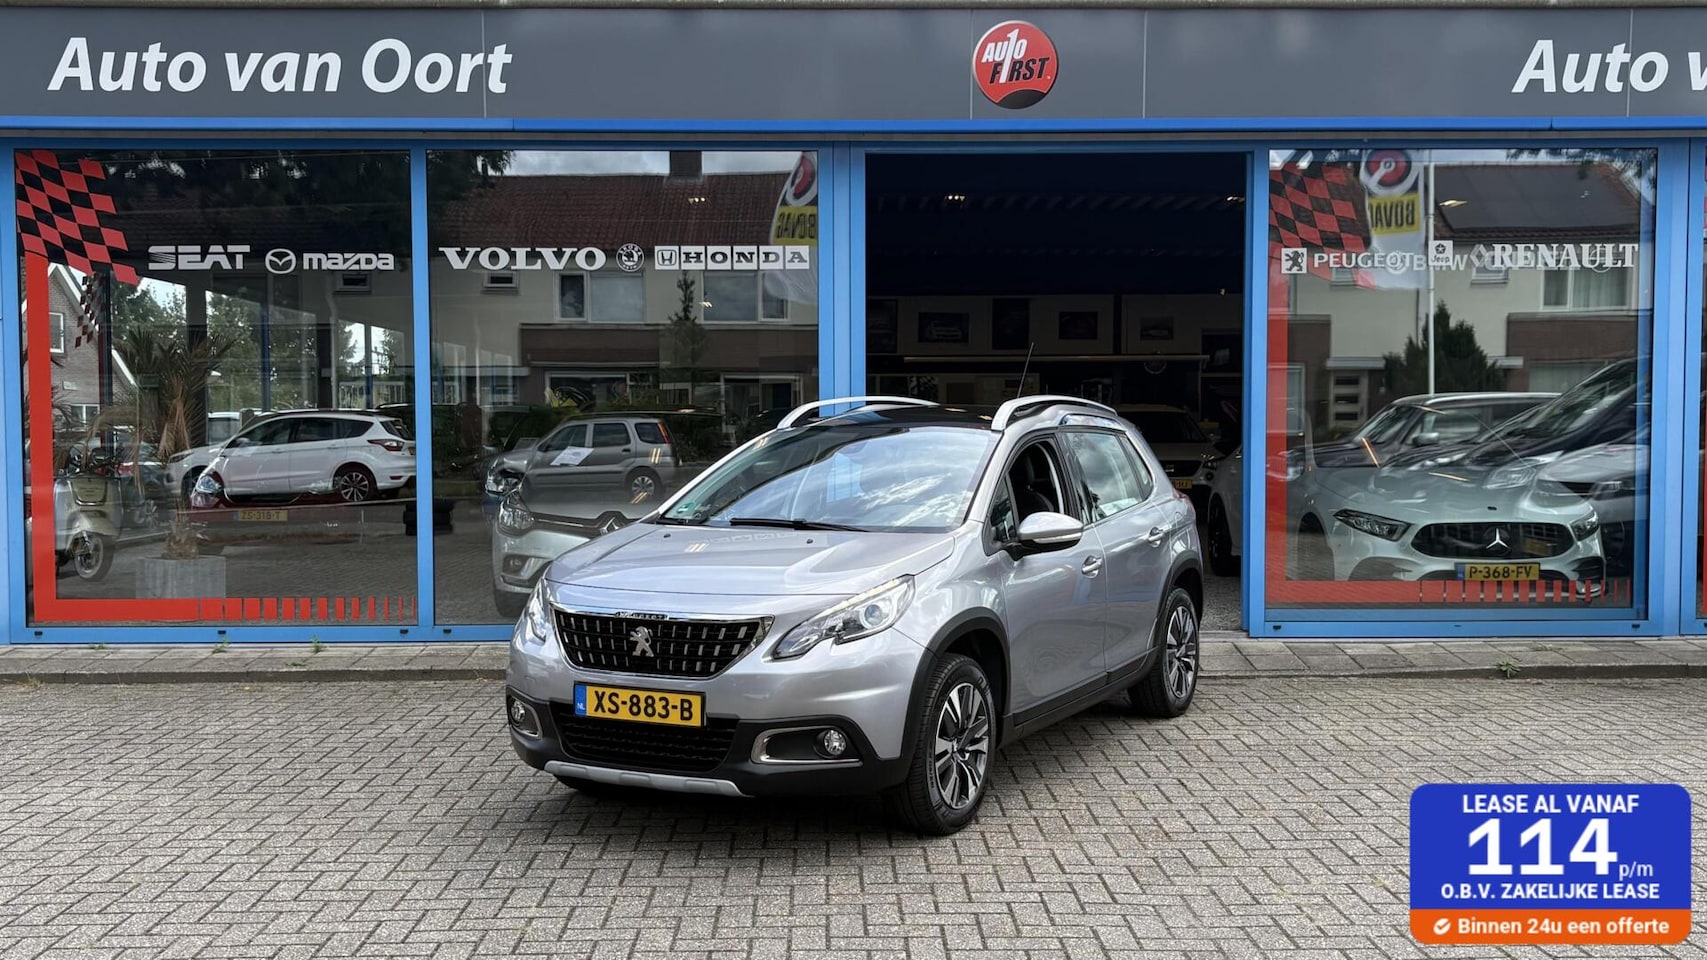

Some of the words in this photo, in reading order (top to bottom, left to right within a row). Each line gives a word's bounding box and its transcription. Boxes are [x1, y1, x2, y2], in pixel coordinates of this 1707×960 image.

[48, 37, 207, 91] Auto
[225, 52, 342, 92] van
[361, 38, 512, 93] Oort
[1511, 39, 1669, 93] Auto
[148, 245, 251, 270] SEAT
[439, 246, 607, 272] VOLVO
[682, 250, 808, 265] HONDA
[1313, 251, 1414, 269] PEUGEOT
[1413, 253, 1469, 272] BW
[1431, 255, 1450, 264] Jeep
[1491, 243, 1639, 268] RENAULT
[1469, 566, 1532, 579] P-368-FV
[577, 702, 585, 710] NL
[594, 690, 693, 720] XS-883-B
